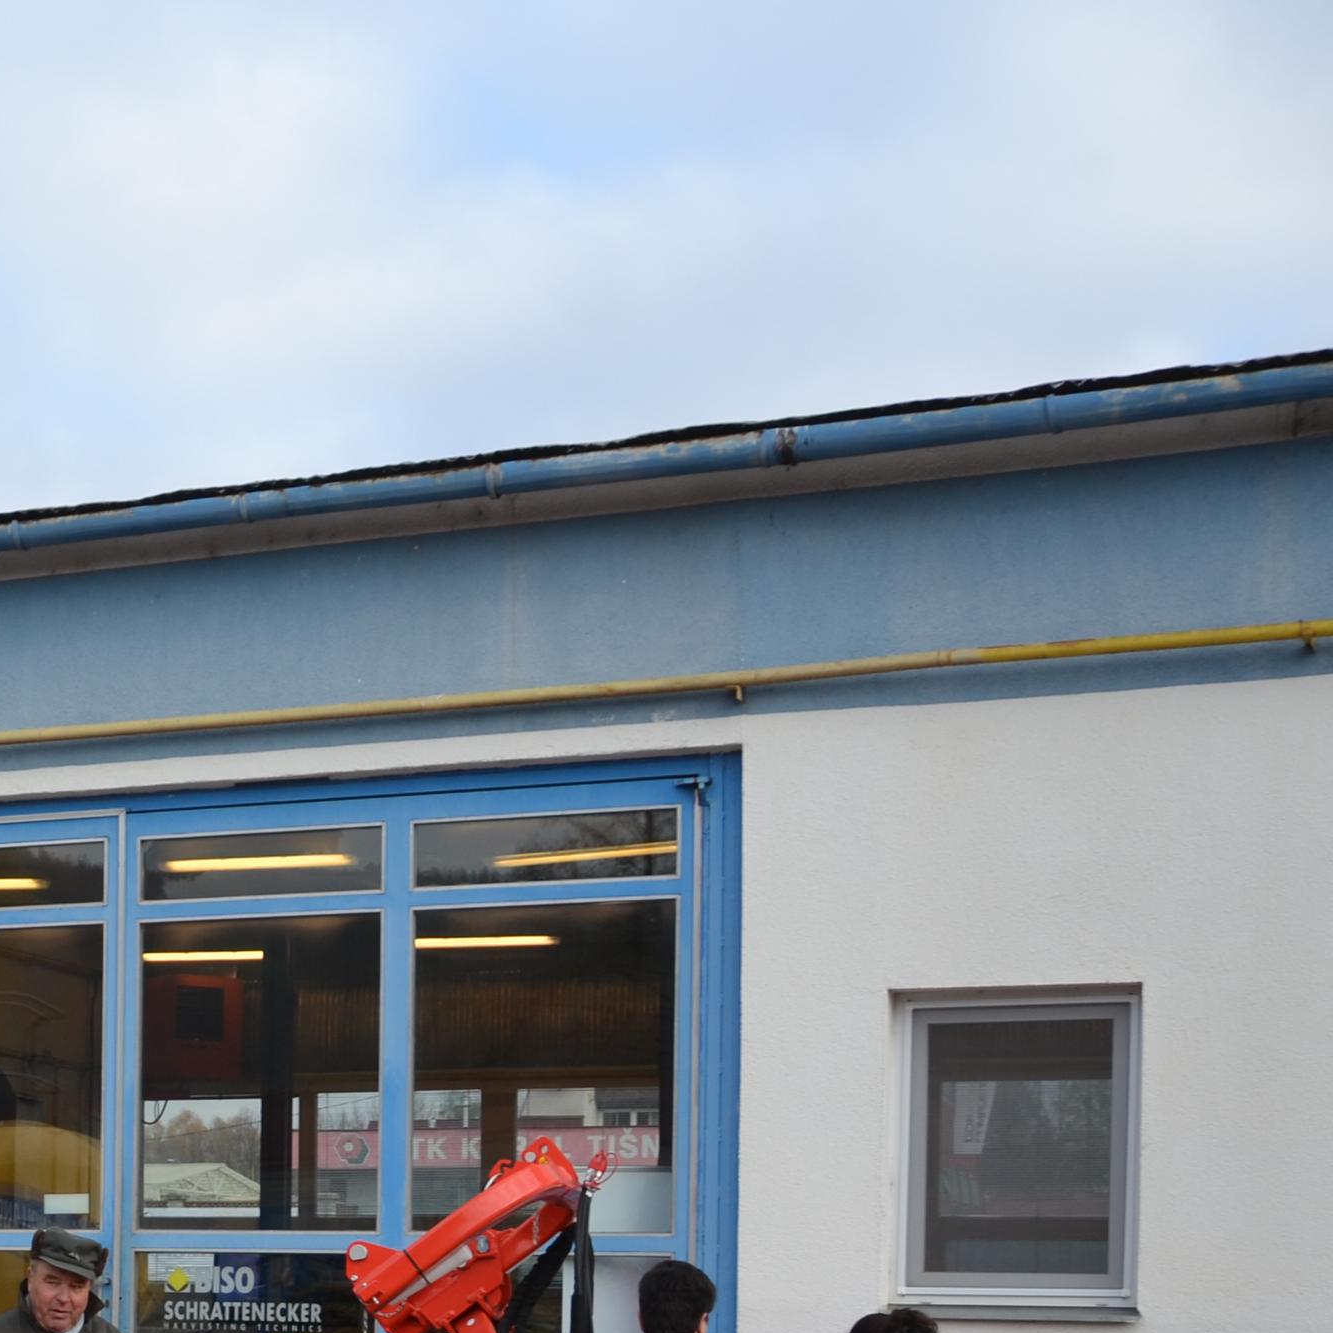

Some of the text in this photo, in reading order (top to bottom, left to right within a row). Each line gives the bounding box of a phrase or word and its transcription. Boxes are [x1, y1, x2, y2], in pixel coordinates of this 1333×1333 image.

[194, 1265, 256, 1294] BISO
[164, 1300, 323, 1324] SCHRATTENECKER
[163, 1322, 323, 1333] HARVESTING TECHNICS
